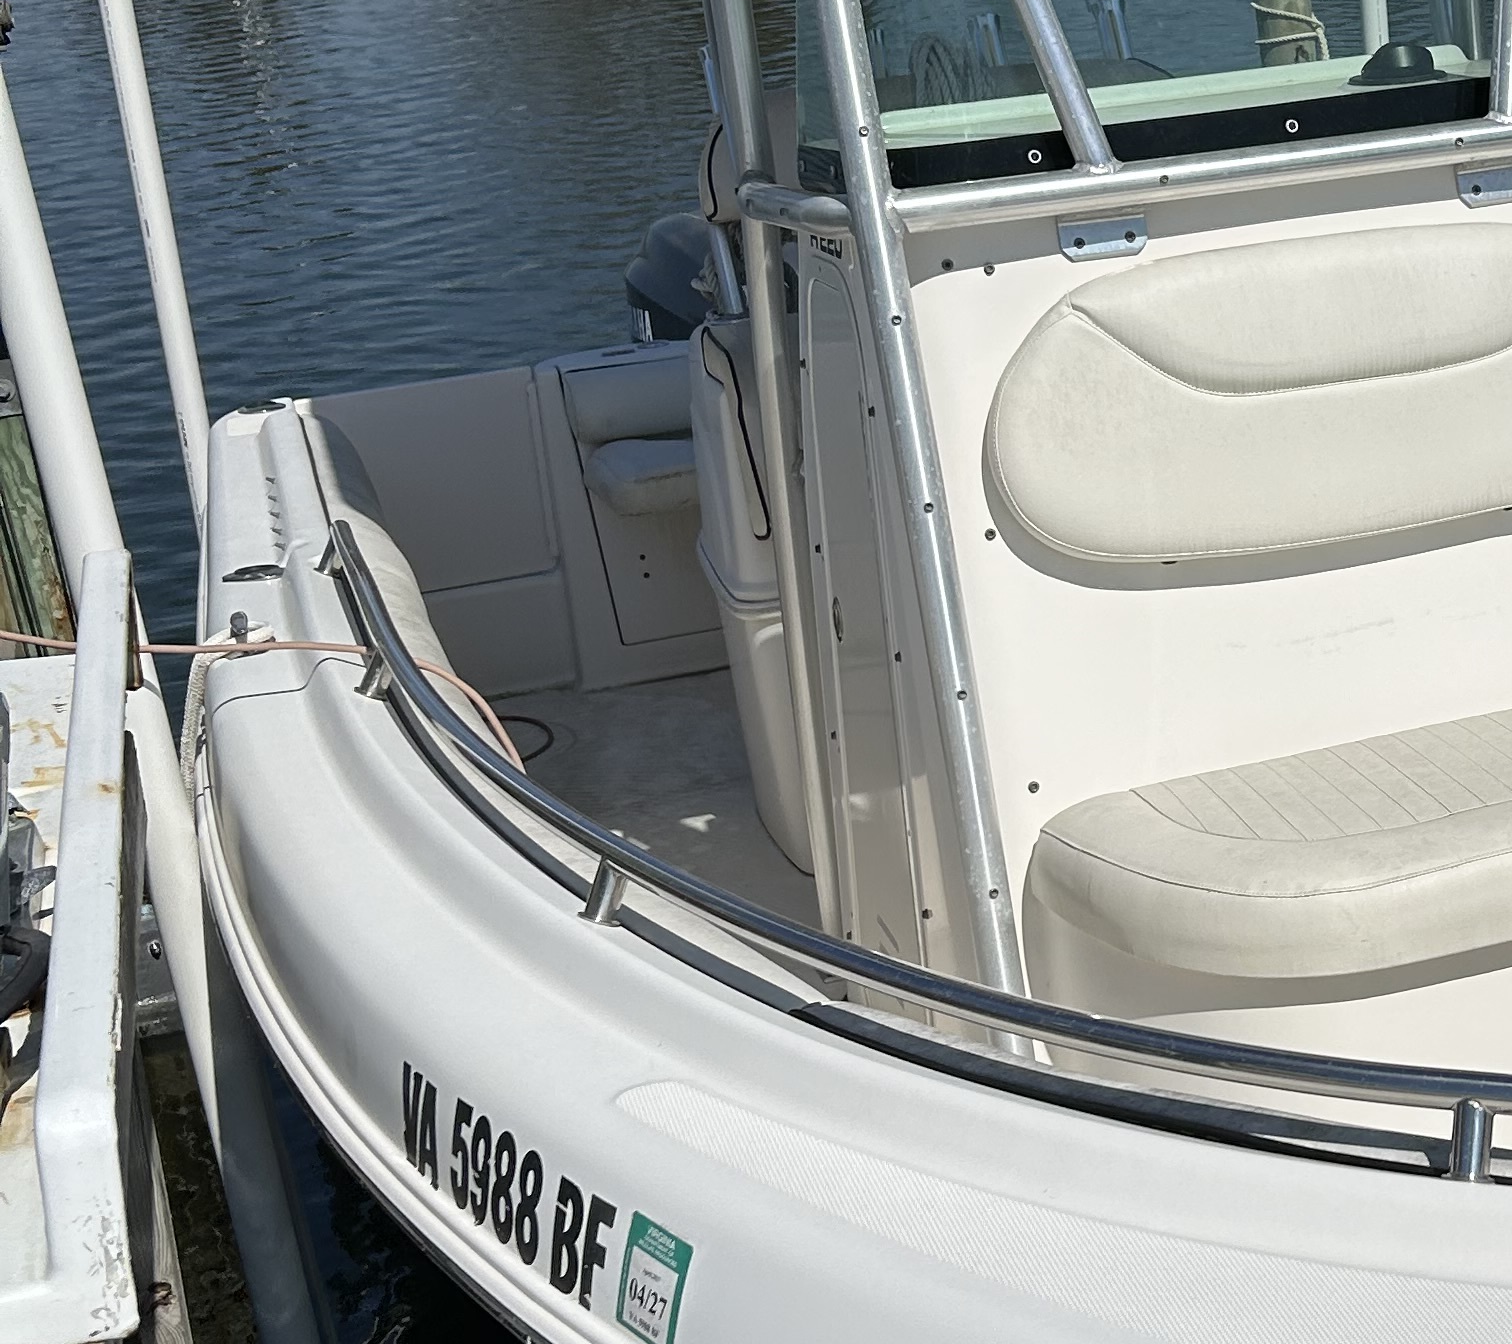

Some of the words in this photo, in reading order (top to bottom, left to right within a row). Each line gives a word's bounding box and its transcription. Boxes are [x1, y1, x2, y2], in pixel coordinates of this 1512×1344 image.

[403, 1061, 439, 1191] VA
[450, 1097, 543, 1266] 5988
[549, 1175, 618, 1311] BF
[629, 1277, 668, 1321] 04/27
